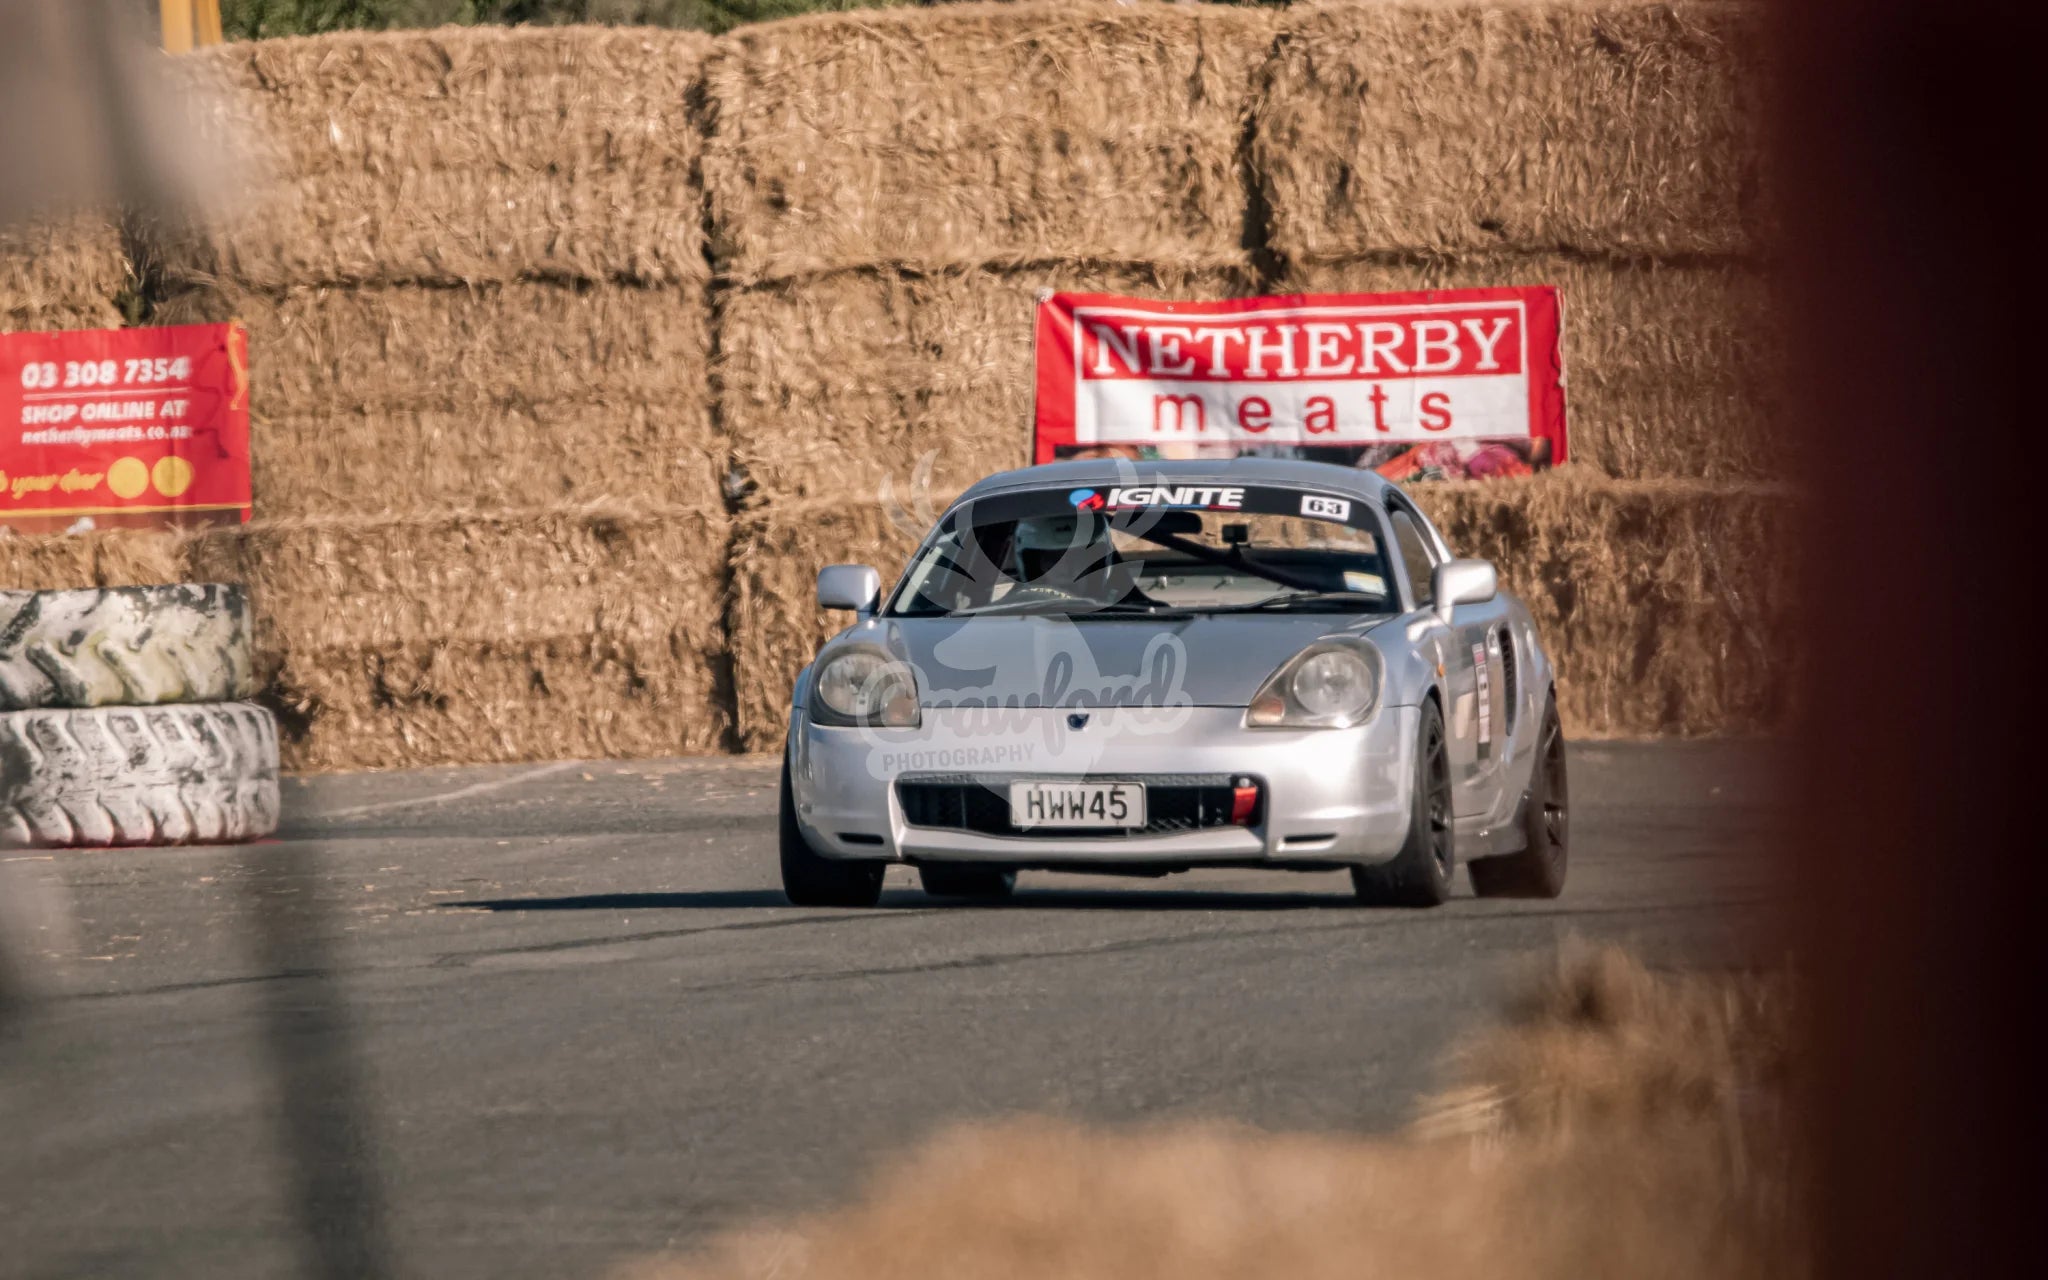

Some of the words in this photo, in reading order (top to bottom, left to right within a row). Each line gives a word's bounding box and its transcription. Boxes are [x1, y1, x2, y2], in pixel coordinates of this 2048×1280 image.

[1091, 317, 1513, 378] NETHERBY
[22, 363, 58, 388] 03
[64, 361, 117, 387] 308
[124, 357, 190, 383] 7354
[21, 404, 79, 424] SHOP
[80, 400, 155, 421] ONLINE
[159, 399, 188, 418] AT
[1150, 383, 1455, 434] meats
[1106, 487, 1245, 507] IGNITE
[1307, 499, 1344, 516] 63
[1026, 790, 1129, 821] HWW45
